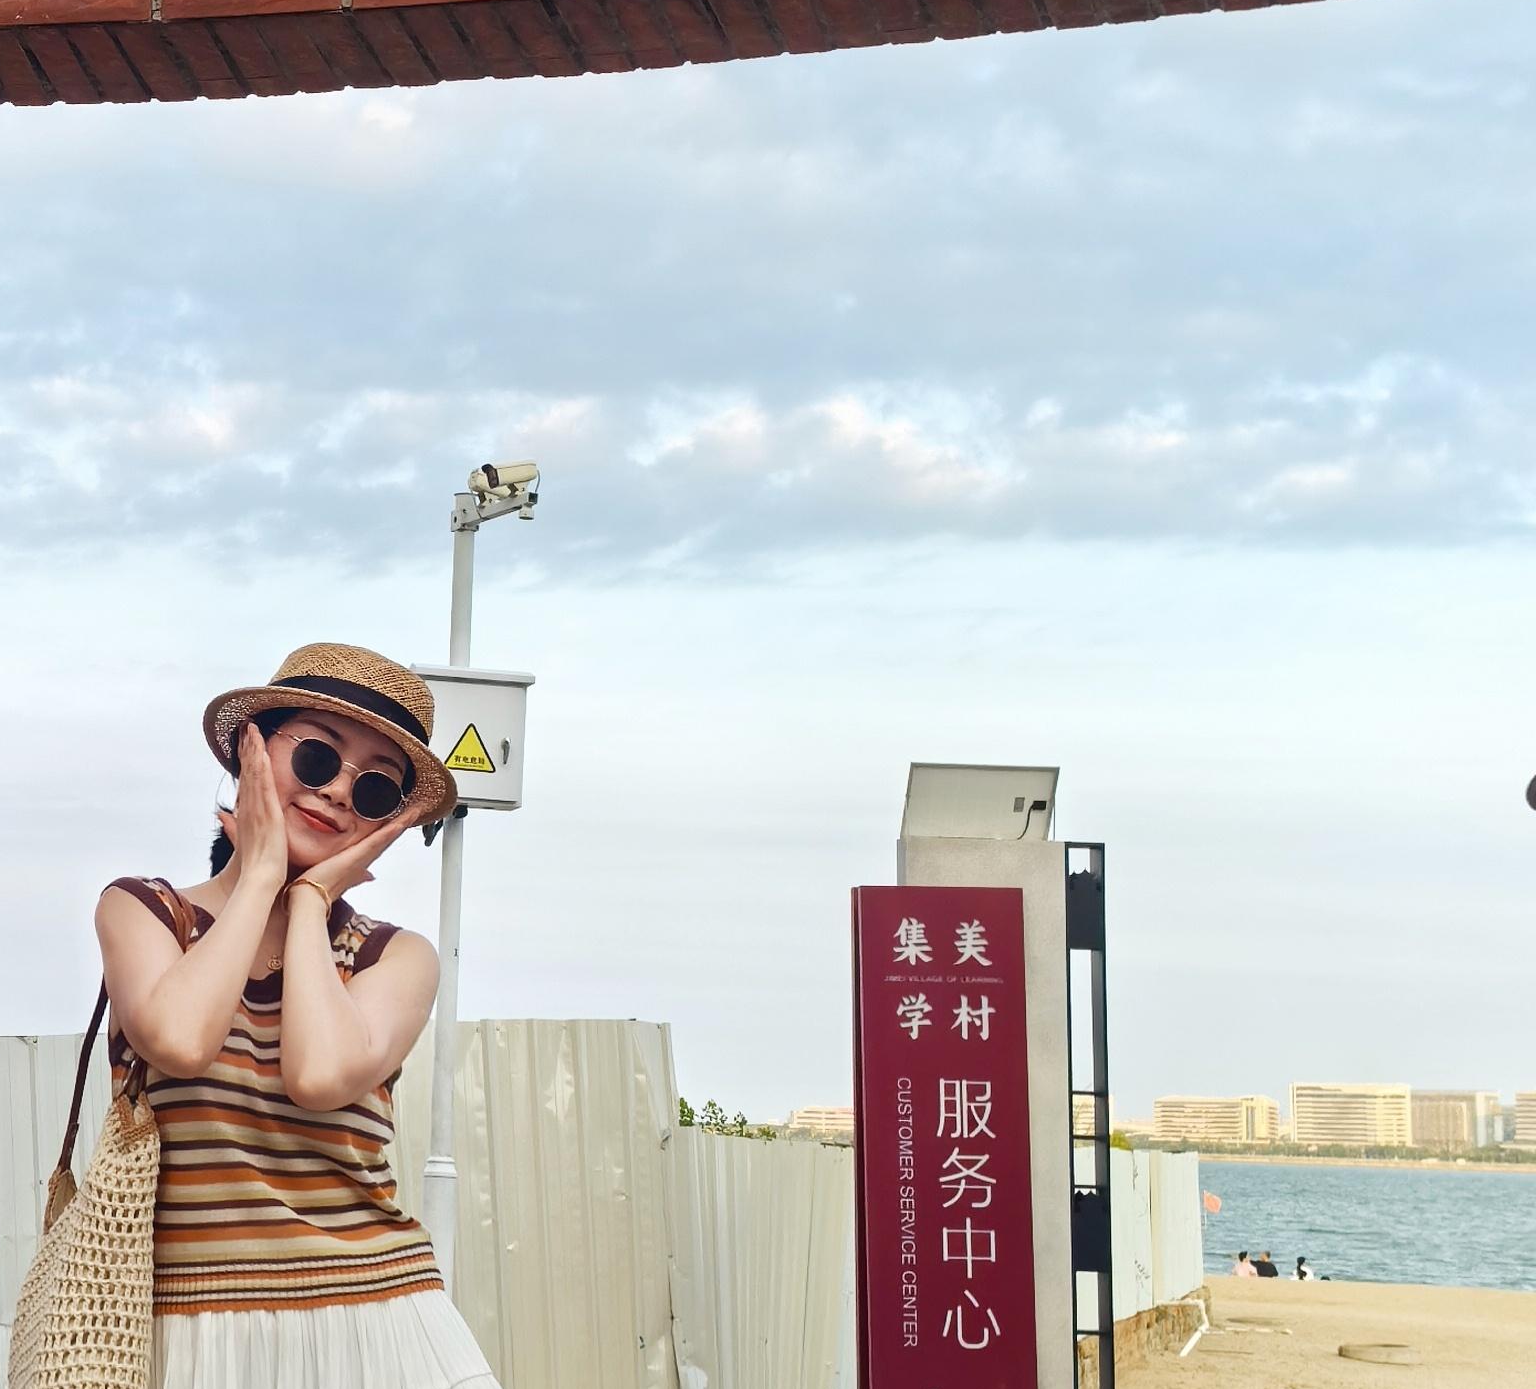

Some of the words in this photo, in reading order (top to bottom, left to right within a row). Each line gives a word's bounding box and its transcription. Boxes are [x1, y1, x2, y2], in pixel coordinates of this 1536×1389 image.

[892, 916, 994, 967] 集美
[895, 992, 997, 1042] 学村
[896, 1077, 915, 1181] CUSTOMER
[899, 1185, 917, 1266] SERVICE
[935, 1077, 1002, 1351] 服务中心
[901, 1269, 919, 1348] CENTER
